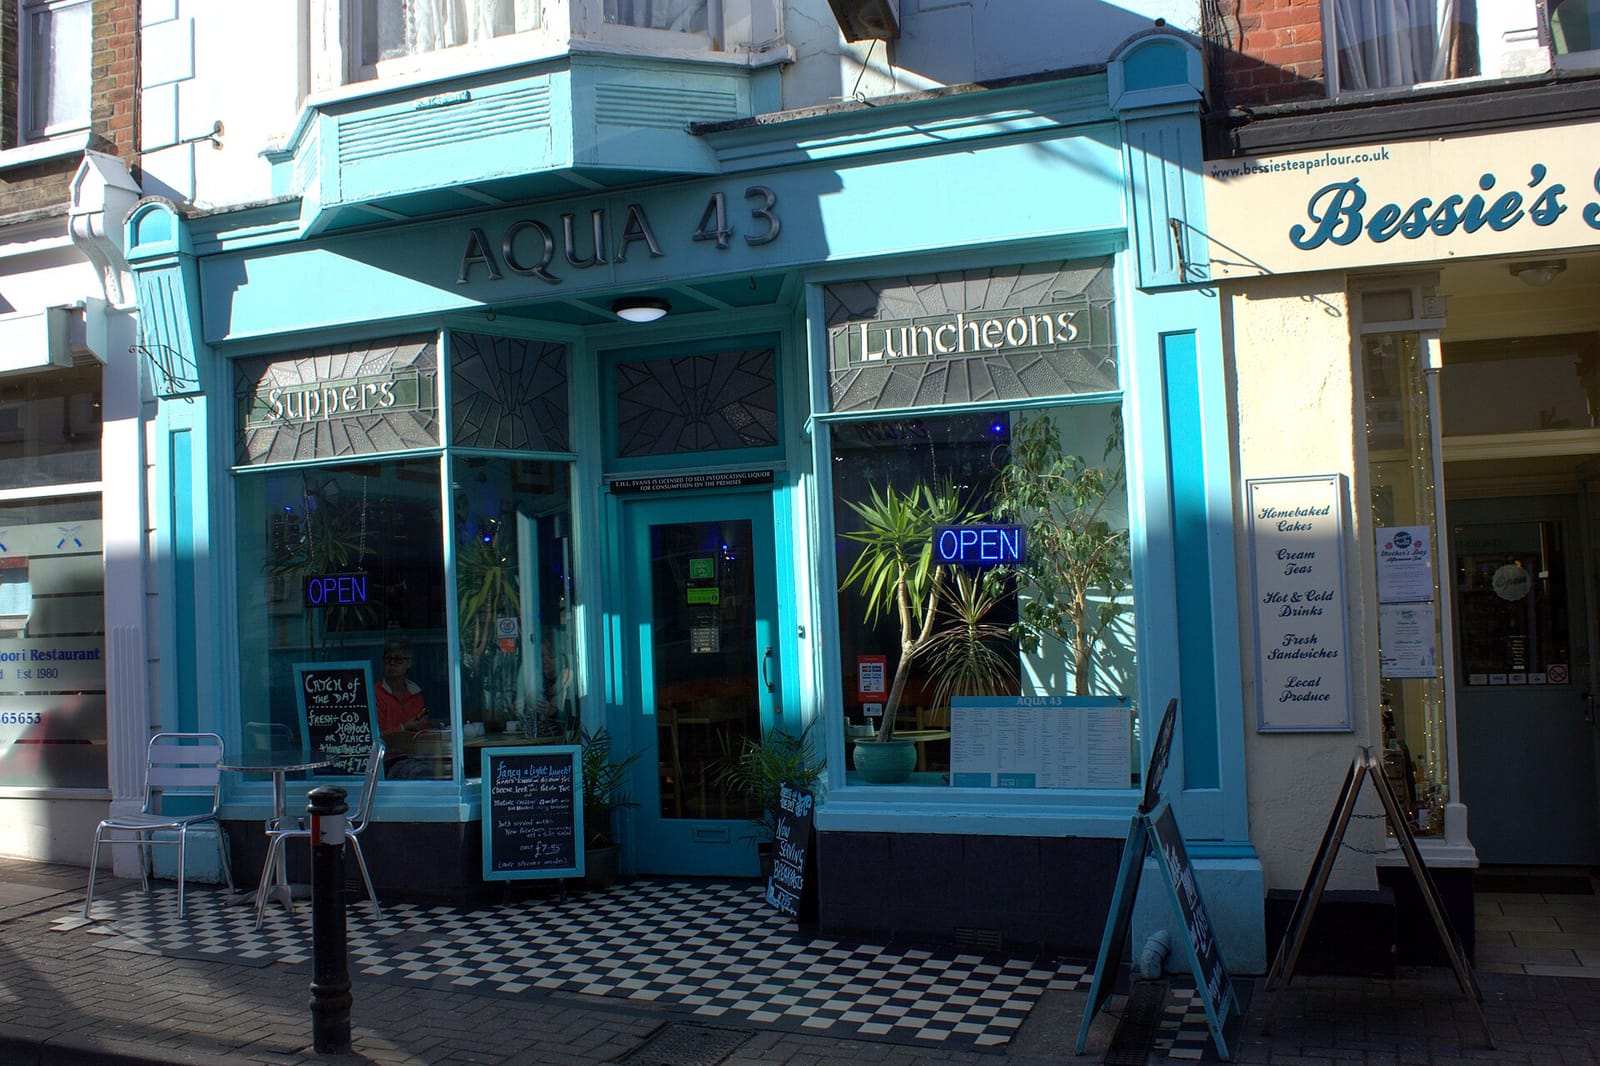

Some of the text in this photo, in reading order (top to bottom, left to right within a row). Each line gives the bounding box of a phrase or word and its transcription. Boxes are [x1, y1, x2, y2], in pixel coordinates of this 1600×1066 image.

[1211, 147, 1390, 178] www.bessiesteaparlour.co.uk
[1289, 163, 1567, 250] Bessie's
[456, 185, 782, 285] AQUA 43
[860, 311, 1080, 361] Luncheons
[266, 381, 397, 421] Suppers
[705, 472, 747, 481] INTOXICATING
[652, 482, 693, 490] CONSUMPTION
[1258, 505, 1331, 519] Homebaked
[1275, 520, 1313, 532] Cakes
[939, 529, 1019, 560] OPEN
[1275, 548, 1316, 561] Cream
[1284, 562, 1313, 576] Teas
[309, 576, 366, 604] OPEN
[1263, 589, 1335, 604] Hot & Cold
[1278, 604, 1324, 618] Drinks
[1282, 633, 1318, 647] Fresh
[30, 648, 100, 661] Restaurant
[1267, 648, 1340, 660] Sandwiches
[17, 668, 32, 679] Est
[36, 667, 59, 679] 1980
[305, 674, 342, 693] CATCH
[1284, 675, 1322, 689] Local
[312, 692, 356, 704] THE DAY
[1016, 696, 1062, 707] AQUA 43
[1279, 690, 1331, 703] Produce
[340, 712, 359, 723] COD
[339, 734, 371, 743] PLAICE
